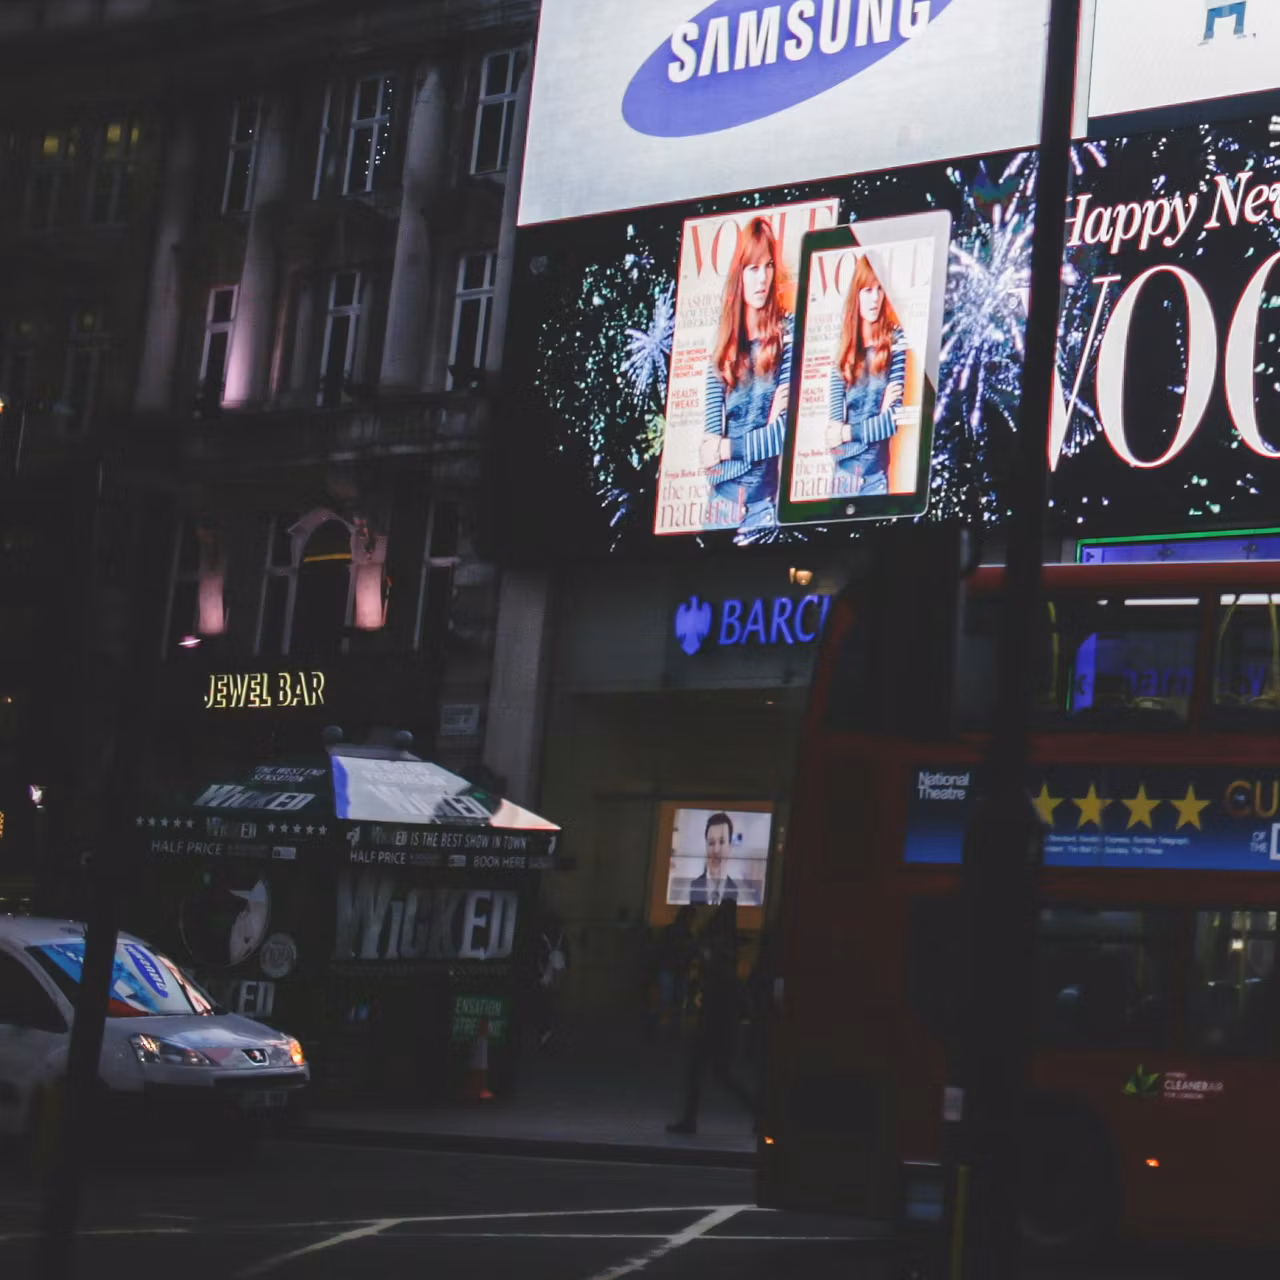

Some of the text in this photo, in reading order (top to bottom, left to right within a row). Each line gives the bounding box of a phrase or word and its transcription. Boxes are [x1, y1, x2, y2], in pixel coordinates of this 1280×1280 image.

[659, 486, 746, 529] natural
[204, 671, 325, 709] JEWEL BAR
[917, 771, 970, 787] National
[917, 786, 967, 801] Theatre
[150, 839, 183, 853] HALF
[186, 841, 223, 856] PRICE
[440, 832, 463, 848] BEST
[350, 850, 375, 864] HALF
[377, 850, 406, 865] PRICE
[473, 854, 526, 868] BOOK HERE
[454, 996, 502, 1017] ENSATION
